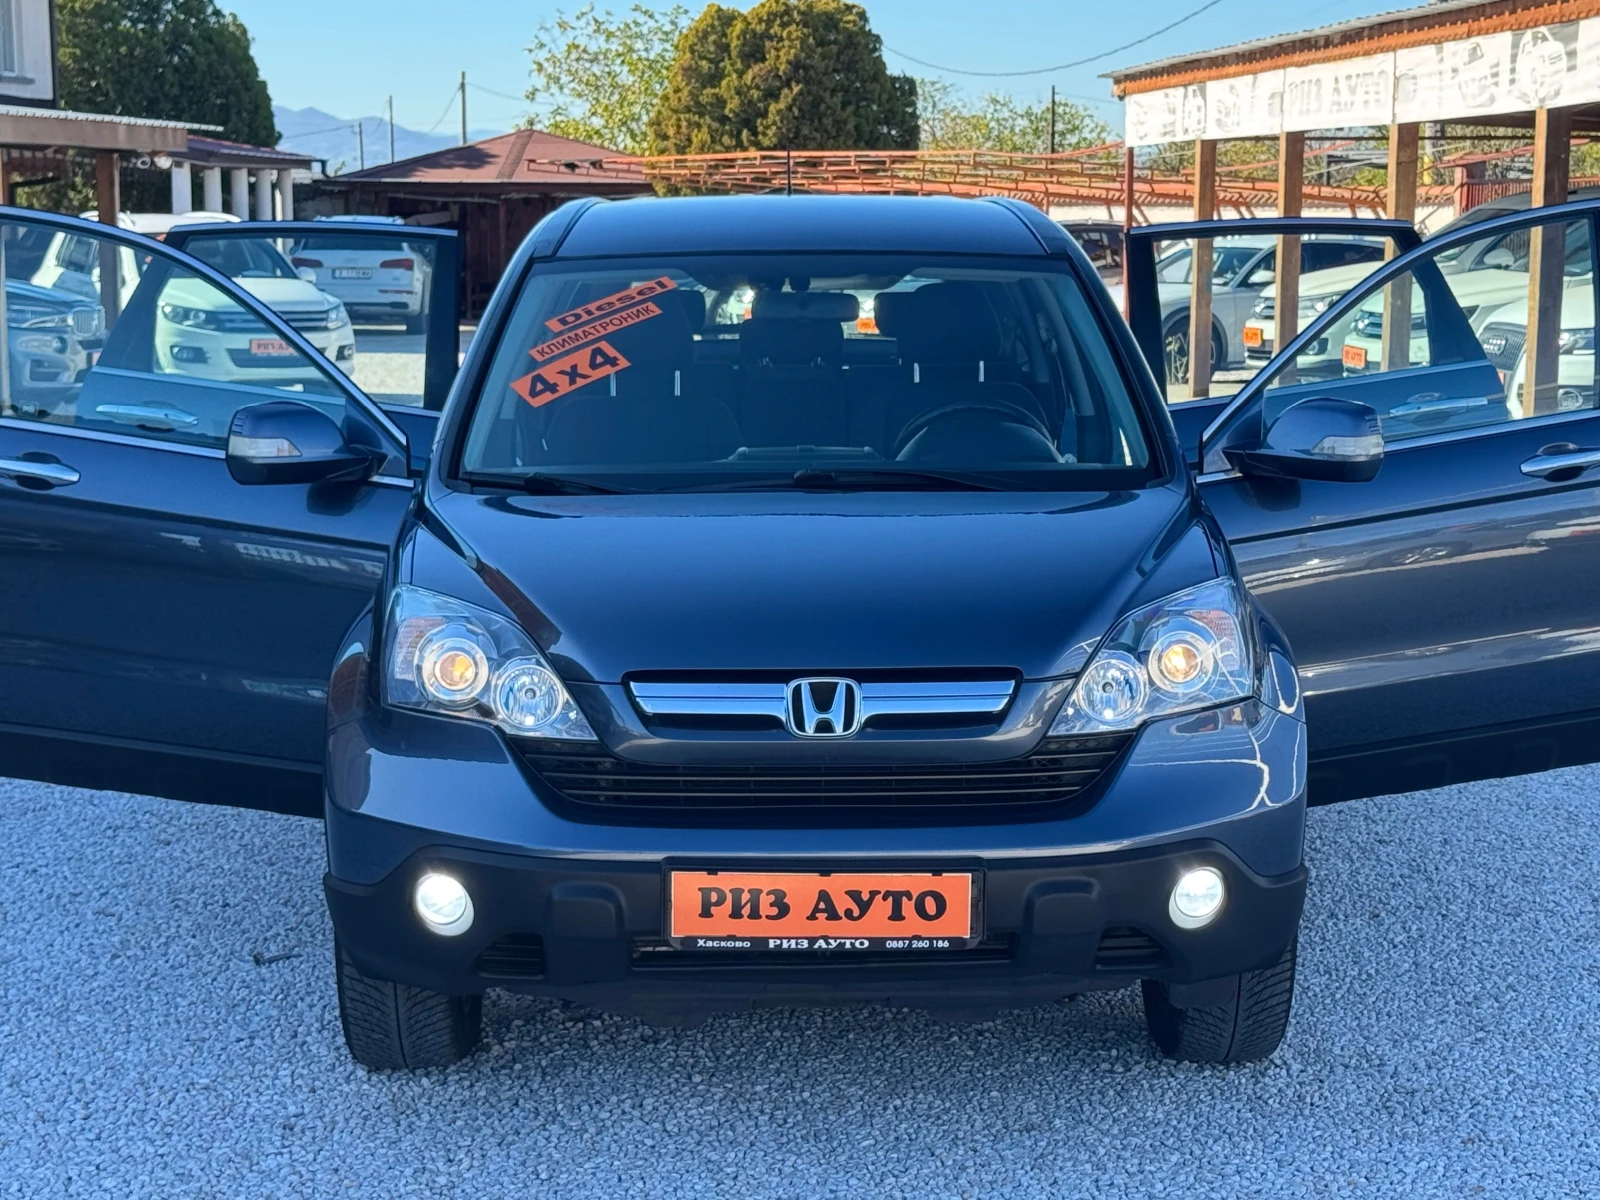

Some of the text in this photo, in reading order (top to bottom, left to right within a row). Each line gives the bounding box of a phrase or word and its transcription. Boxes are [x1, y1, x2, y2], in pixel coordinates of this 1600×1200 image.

[557, 280, 669, 327] Diesel
[536, 306, 657, 358] КЛИМАТРОНИК
[528, 346, 621, 399] 4x4
[697, 886, 947, 922] РИЗ АУТО
[697, 938, 950, 949] Хасково РИЗ АУТО 0887 260 186
